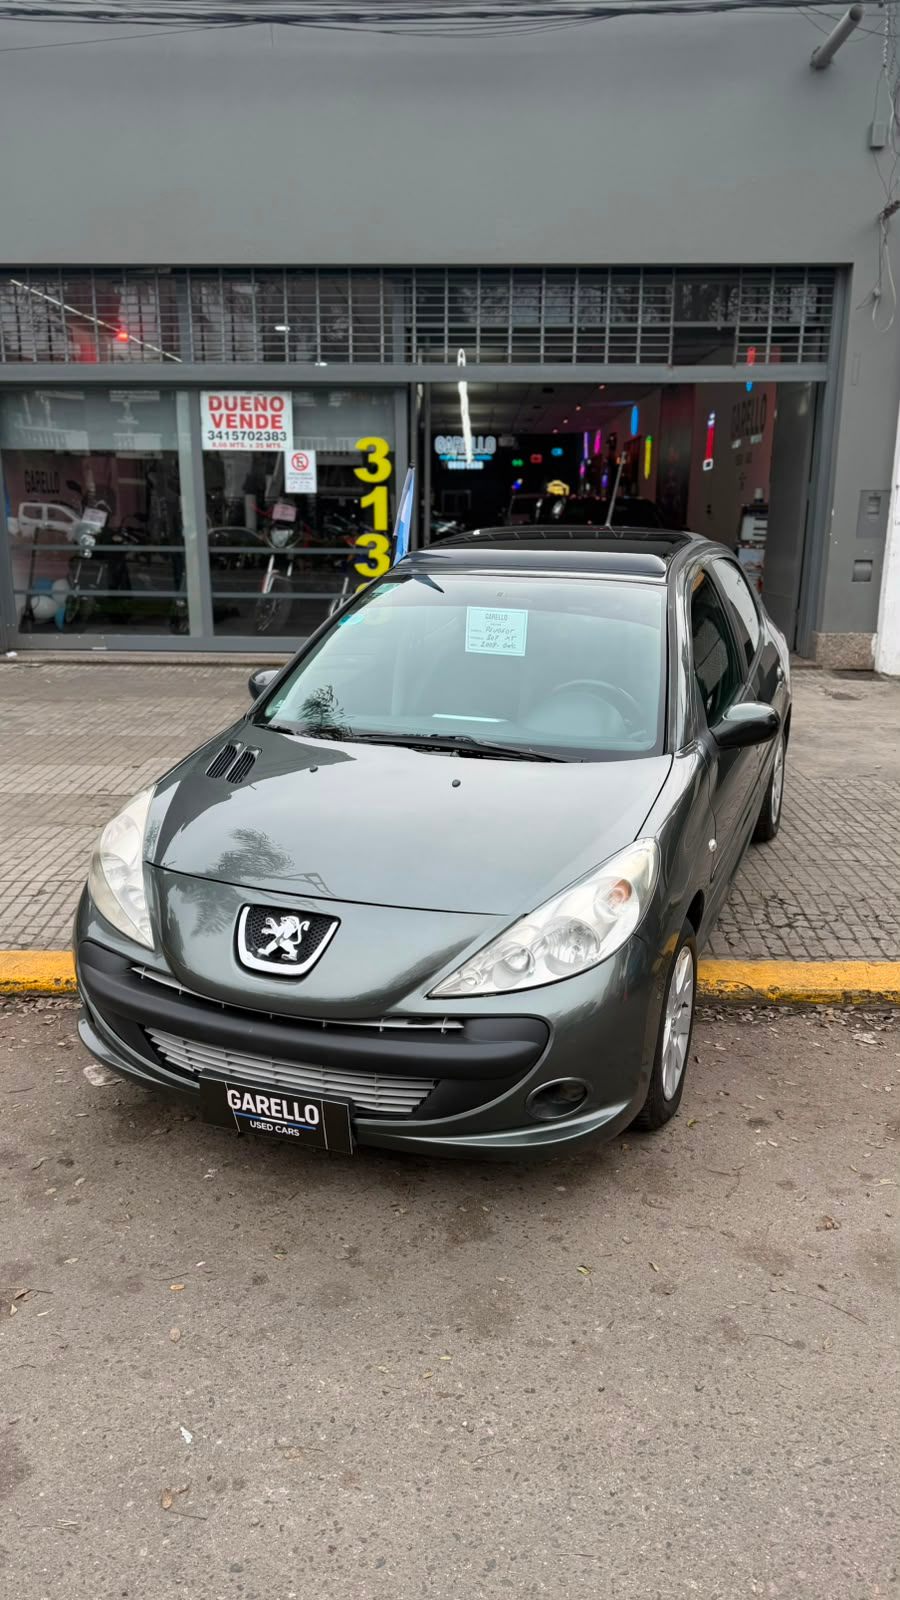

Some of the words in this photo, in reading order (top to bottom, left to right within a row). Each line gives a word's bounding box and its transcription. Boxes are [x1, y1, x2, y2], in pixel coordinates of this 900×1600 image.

[208, 393, 285, 412] DUEÑO
[210, 413, 283, 429] VENDE
[207, 431, 287, 441] 3415702383
[226, 1089, 320, 1125] GARELLO
[250, 1120, 273, 1131] USED
[275, 1126, 300, 1137] CARS
